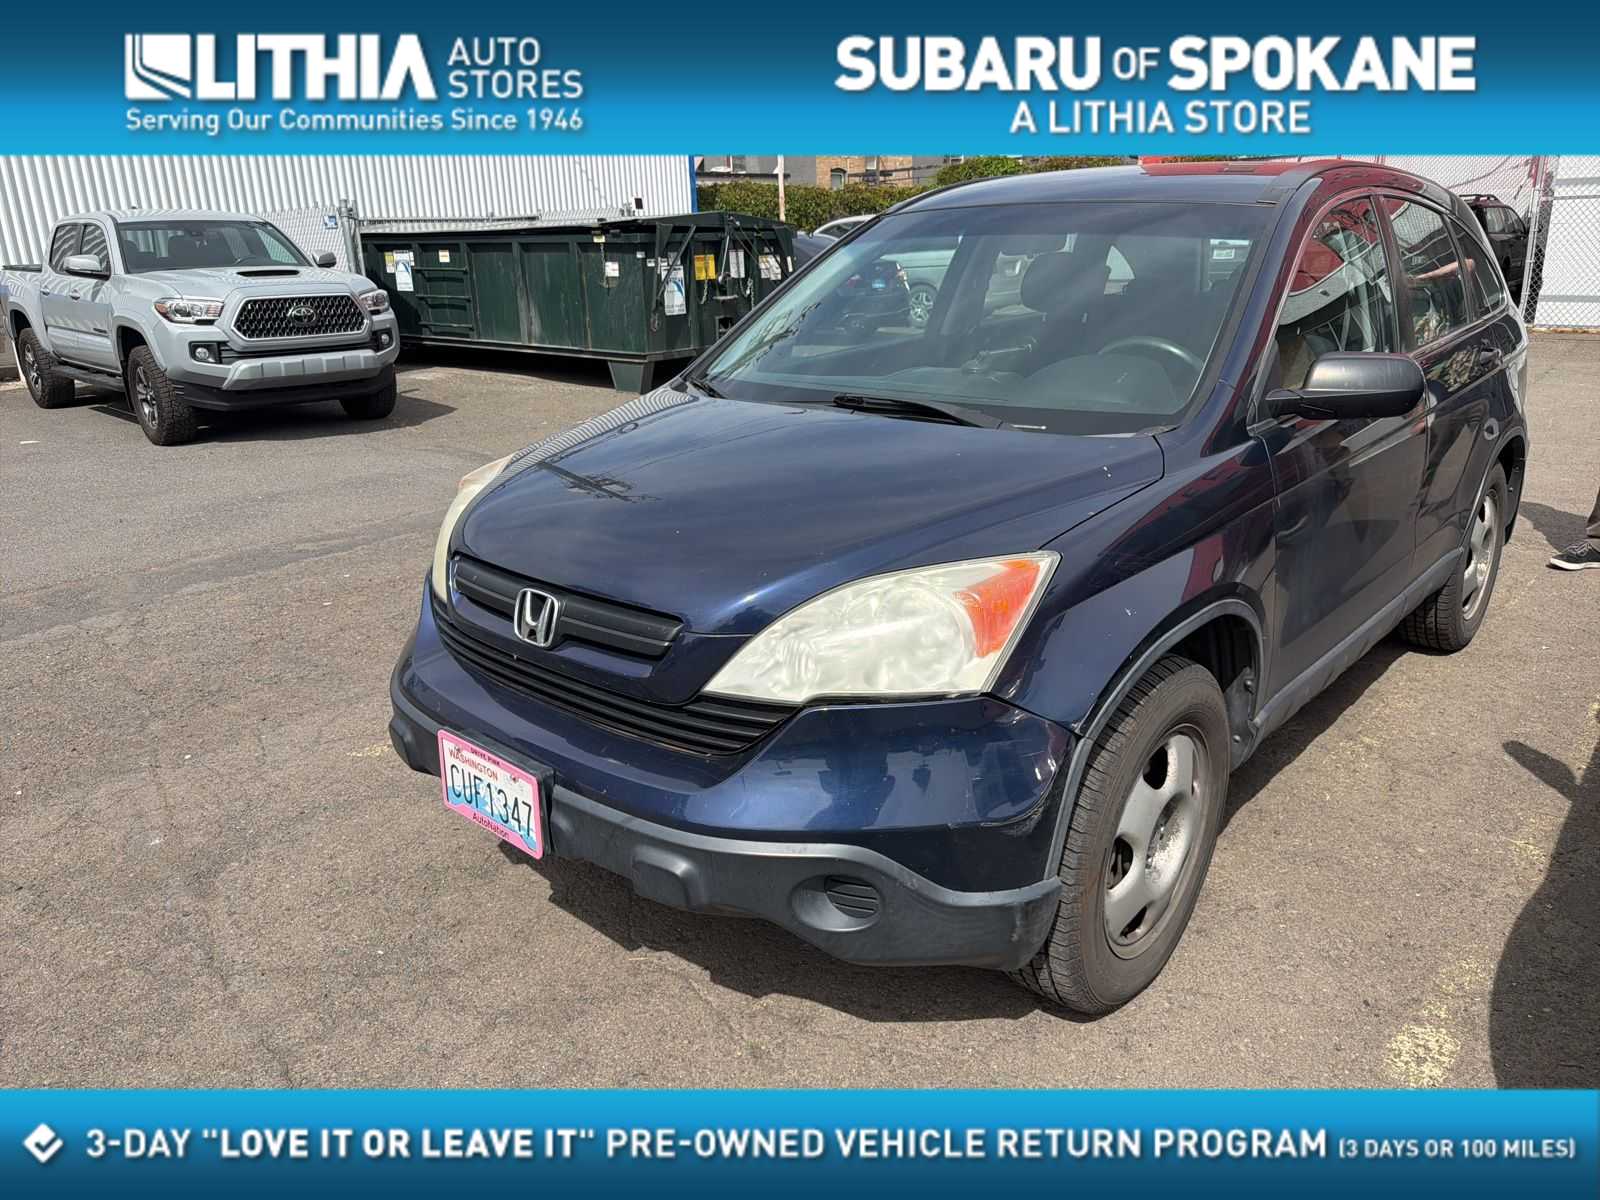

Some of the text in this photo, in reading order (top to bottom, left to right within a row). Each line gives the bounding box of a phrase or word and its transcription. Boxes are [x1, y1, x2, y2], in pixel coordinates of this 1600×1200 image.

[448, 747, 498, 780] WASHINGTON
[450, 763, 532, 838] CUF1347
[472, 811, 510, 840] AutoNation
